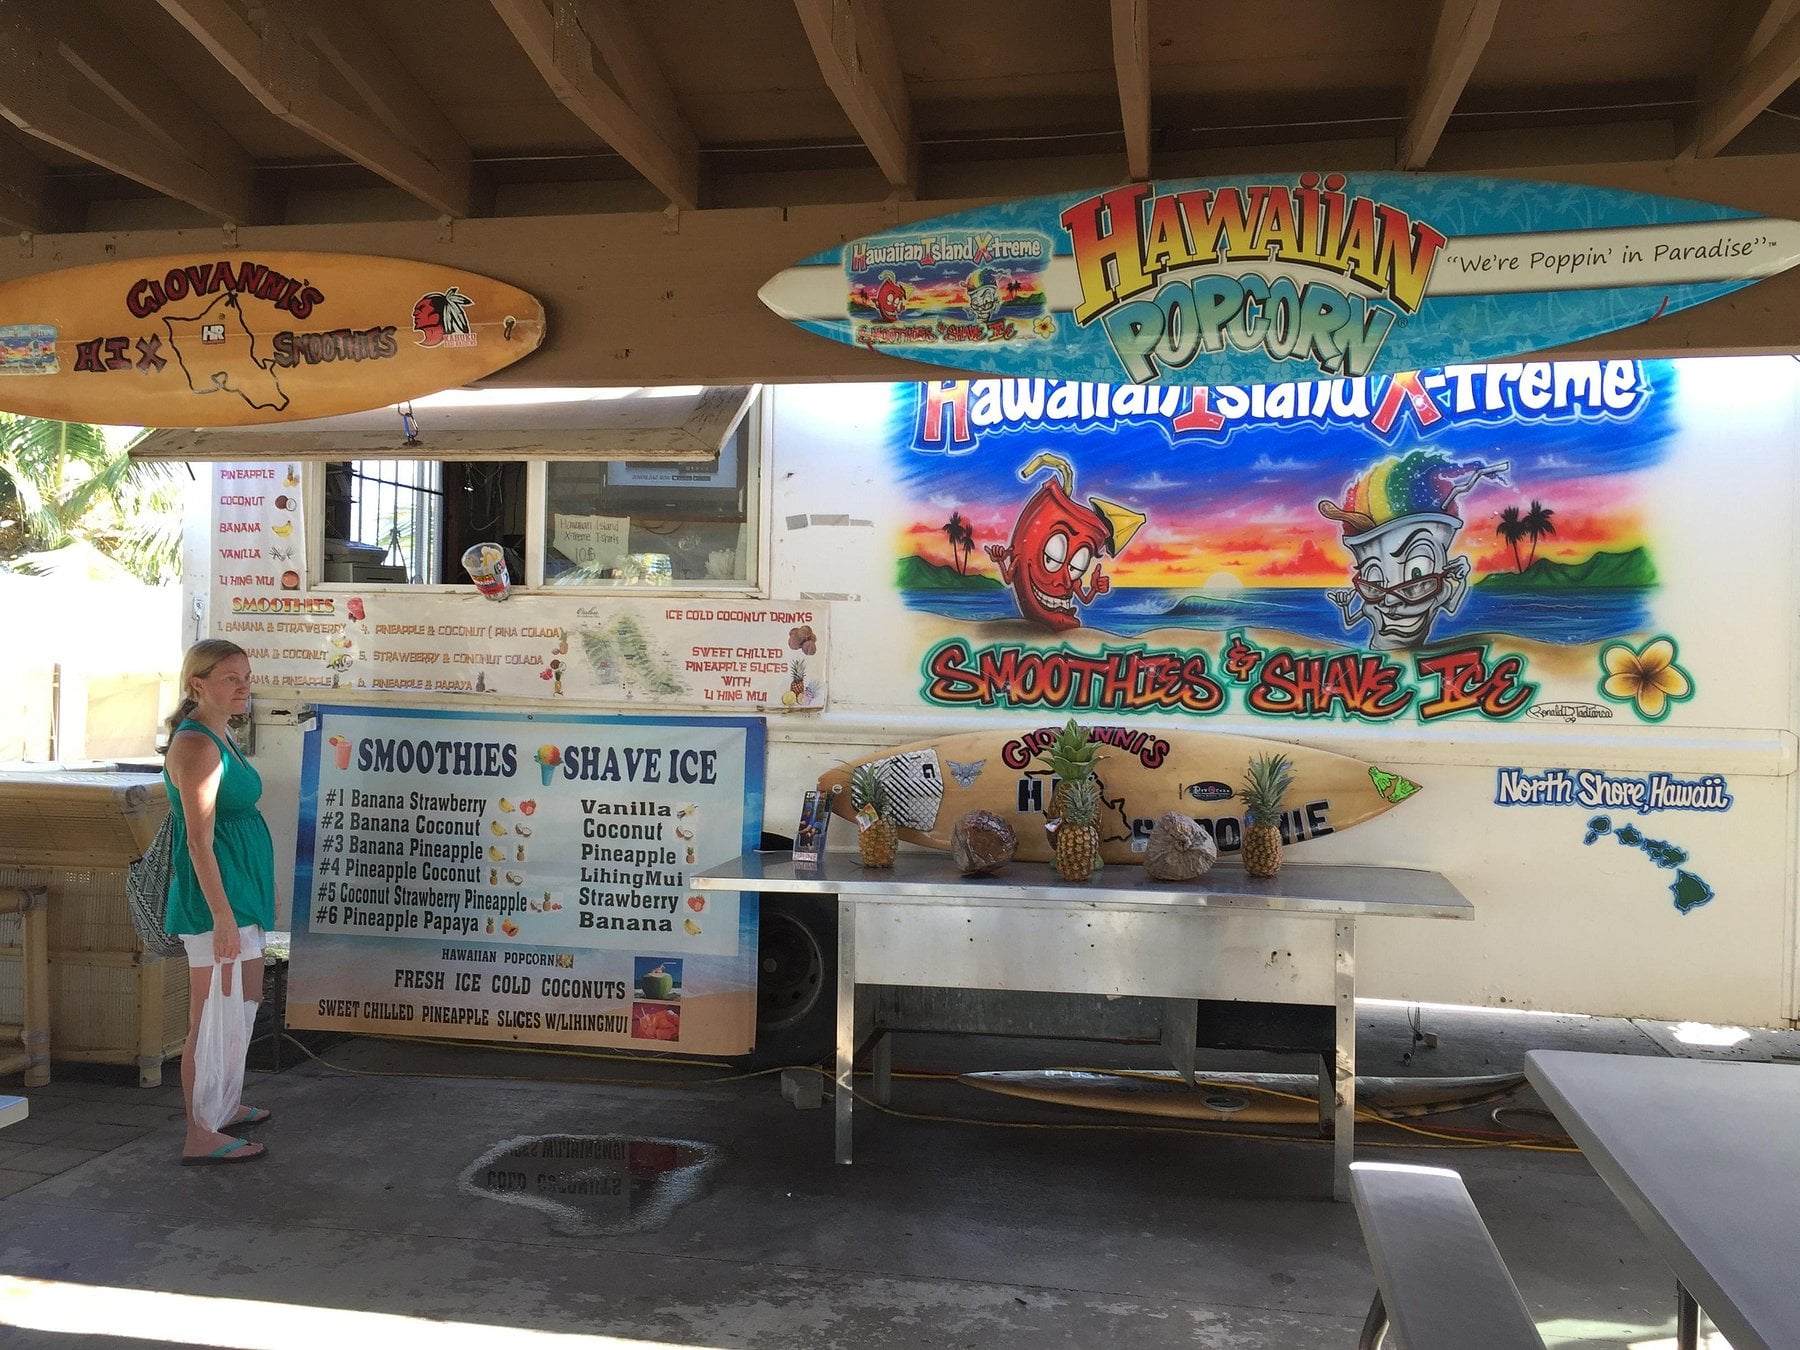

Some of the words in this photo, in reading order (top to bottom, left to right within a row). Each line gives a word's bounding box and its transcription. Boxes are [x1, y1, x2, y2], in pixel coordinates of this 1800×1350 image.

[851, 242, 922, 271] Hawaiian
[920, 236, 974, 266] Island
[974, 231, 1041, 265] X-treme
[1530, 248, 1612, 274] Poppin'
[1623, 245, 1643, 264] in
[126, 261, 325, 319] GIOVANNI'S
[1102, 271, 1397, 384] POPCORN
[272, 326, 397, 368] SMOOTHIES
[220, 469, 275, 479] PINEAPPLE
[220, 496, 265, 506] COCONUT
[219, 522, 261, 533] BANANA
[219, 549, 261, 560] VANILLA
[230, 575, 252, 586] HING
[256, 576, 275, 586] MUI
[232, 597, 336, 613] SMOOTHIES
[666, 610, 682, 621] ICE
[686, 610, 713, 621] COLD
[717, 610, 767, 622] COCONUT
[770, 611, 812, 623] DRINKS
[225, 621, 264, 632] BANANA
[267, 622, 274, 632] &
[277, 622, 346, 634] STRAWBERRY
[375, 624, 424, 635] PINEAPPLE
[427, 625, 435, 635] &
[438, 626, 485, 637] COCONUT
[272, 649, 280, 659] &
[282, 649, 328, 660] COCONUT
[373, 651, 440, 663] STRAWBERRY
[442, 652, 450, 663] &
[505, 654, 543, 665] COLADA
[692, 646, 733, 658] SWEET
[736, 647, 782, 659] CHILLED
[685, 661, 747, 672] PINEAPPLE
[750, 662, 788, 673] SLICES
[272, 675, 280, 685] &
[282, 675, 331, 687] PINEAPPLE
[372, 679, 423, 689] PINEAPPLE
[425, 680, 432, 690] &
[435, 680, 472, 691] PAPAYA
[721, 675, 751, 687] WITH
[928, 643, 1226, 713] SMOOTHIES
[1225, 637, 1260, 682] &
[1251, 653, 1415, 720] SHAVE
[1416, 646, 1537, 721] ICE
[716, 690, 742, 701] HING
[746, 690, 767, 702] MUI
[357, 738, 518, 777] SMOOTHIES
[563, 745, 661, 783] SHAVE
[668, 749, 717, 784] ICE
[1498, 769, 1573, 804] North
[1576, 770, 1650, 812] Shore,
[1649, 774, 1730, 809] Hawaii
[325, 788, 344, 806] #1
[351, 789, 404, 810] Banana
[409, 791, 486, 817] Strawberry
[581, 800, 671, 817] Vanilla
[321, 811, 344, 830] #2
[350, 811, 409, 832] Banana
[416, 815, 480, 836] Coconut
[583, 818, 663, 840] Coconut
[322, 834, 344, 853] #3
[349, 836, 404, 856] Banana
[409, 838, 483, 863] Pineapple
[581, 843, 676, 867] Pineapple
[319, 857, 340, 876] #4
[345, 858, 416, 883] Pineapple
[422, 861, 480, 883] Coconut
[317, 882, 336, 902] #5
[340, 883, 389, 905] Coconut
[394, 885, 460, 912] Strawberry
[464, 889, 527, 915] Pineapple
[579, 887, 679, 913] Strawberry
[316, 905, 338, 924] #6
[343, 907, 424, 932] Pineapple
[424, 910, 479, 935] Papaya
[579, 911, 672, 932] Banana
[441, 948, 497, 963] HAWAIIAN
[504, 951, 556, 966] POPCORN
[394, 969, 445, 990] FRESH
[455, 973, 481, 992] ICE
[491, 974, 530, 995] COLD
[541, 977, 625, 1000] COCONUTS
[318, 999, 360, 1018] SWEET
[363, 1001, 413, 1021] CHILLED
[422, 1005, 489, 1026] PINEAPPLE
[497, 1009, 541, 1029] SLICES
[545, 1012, 628, 1034] W/LIHINGMUI
